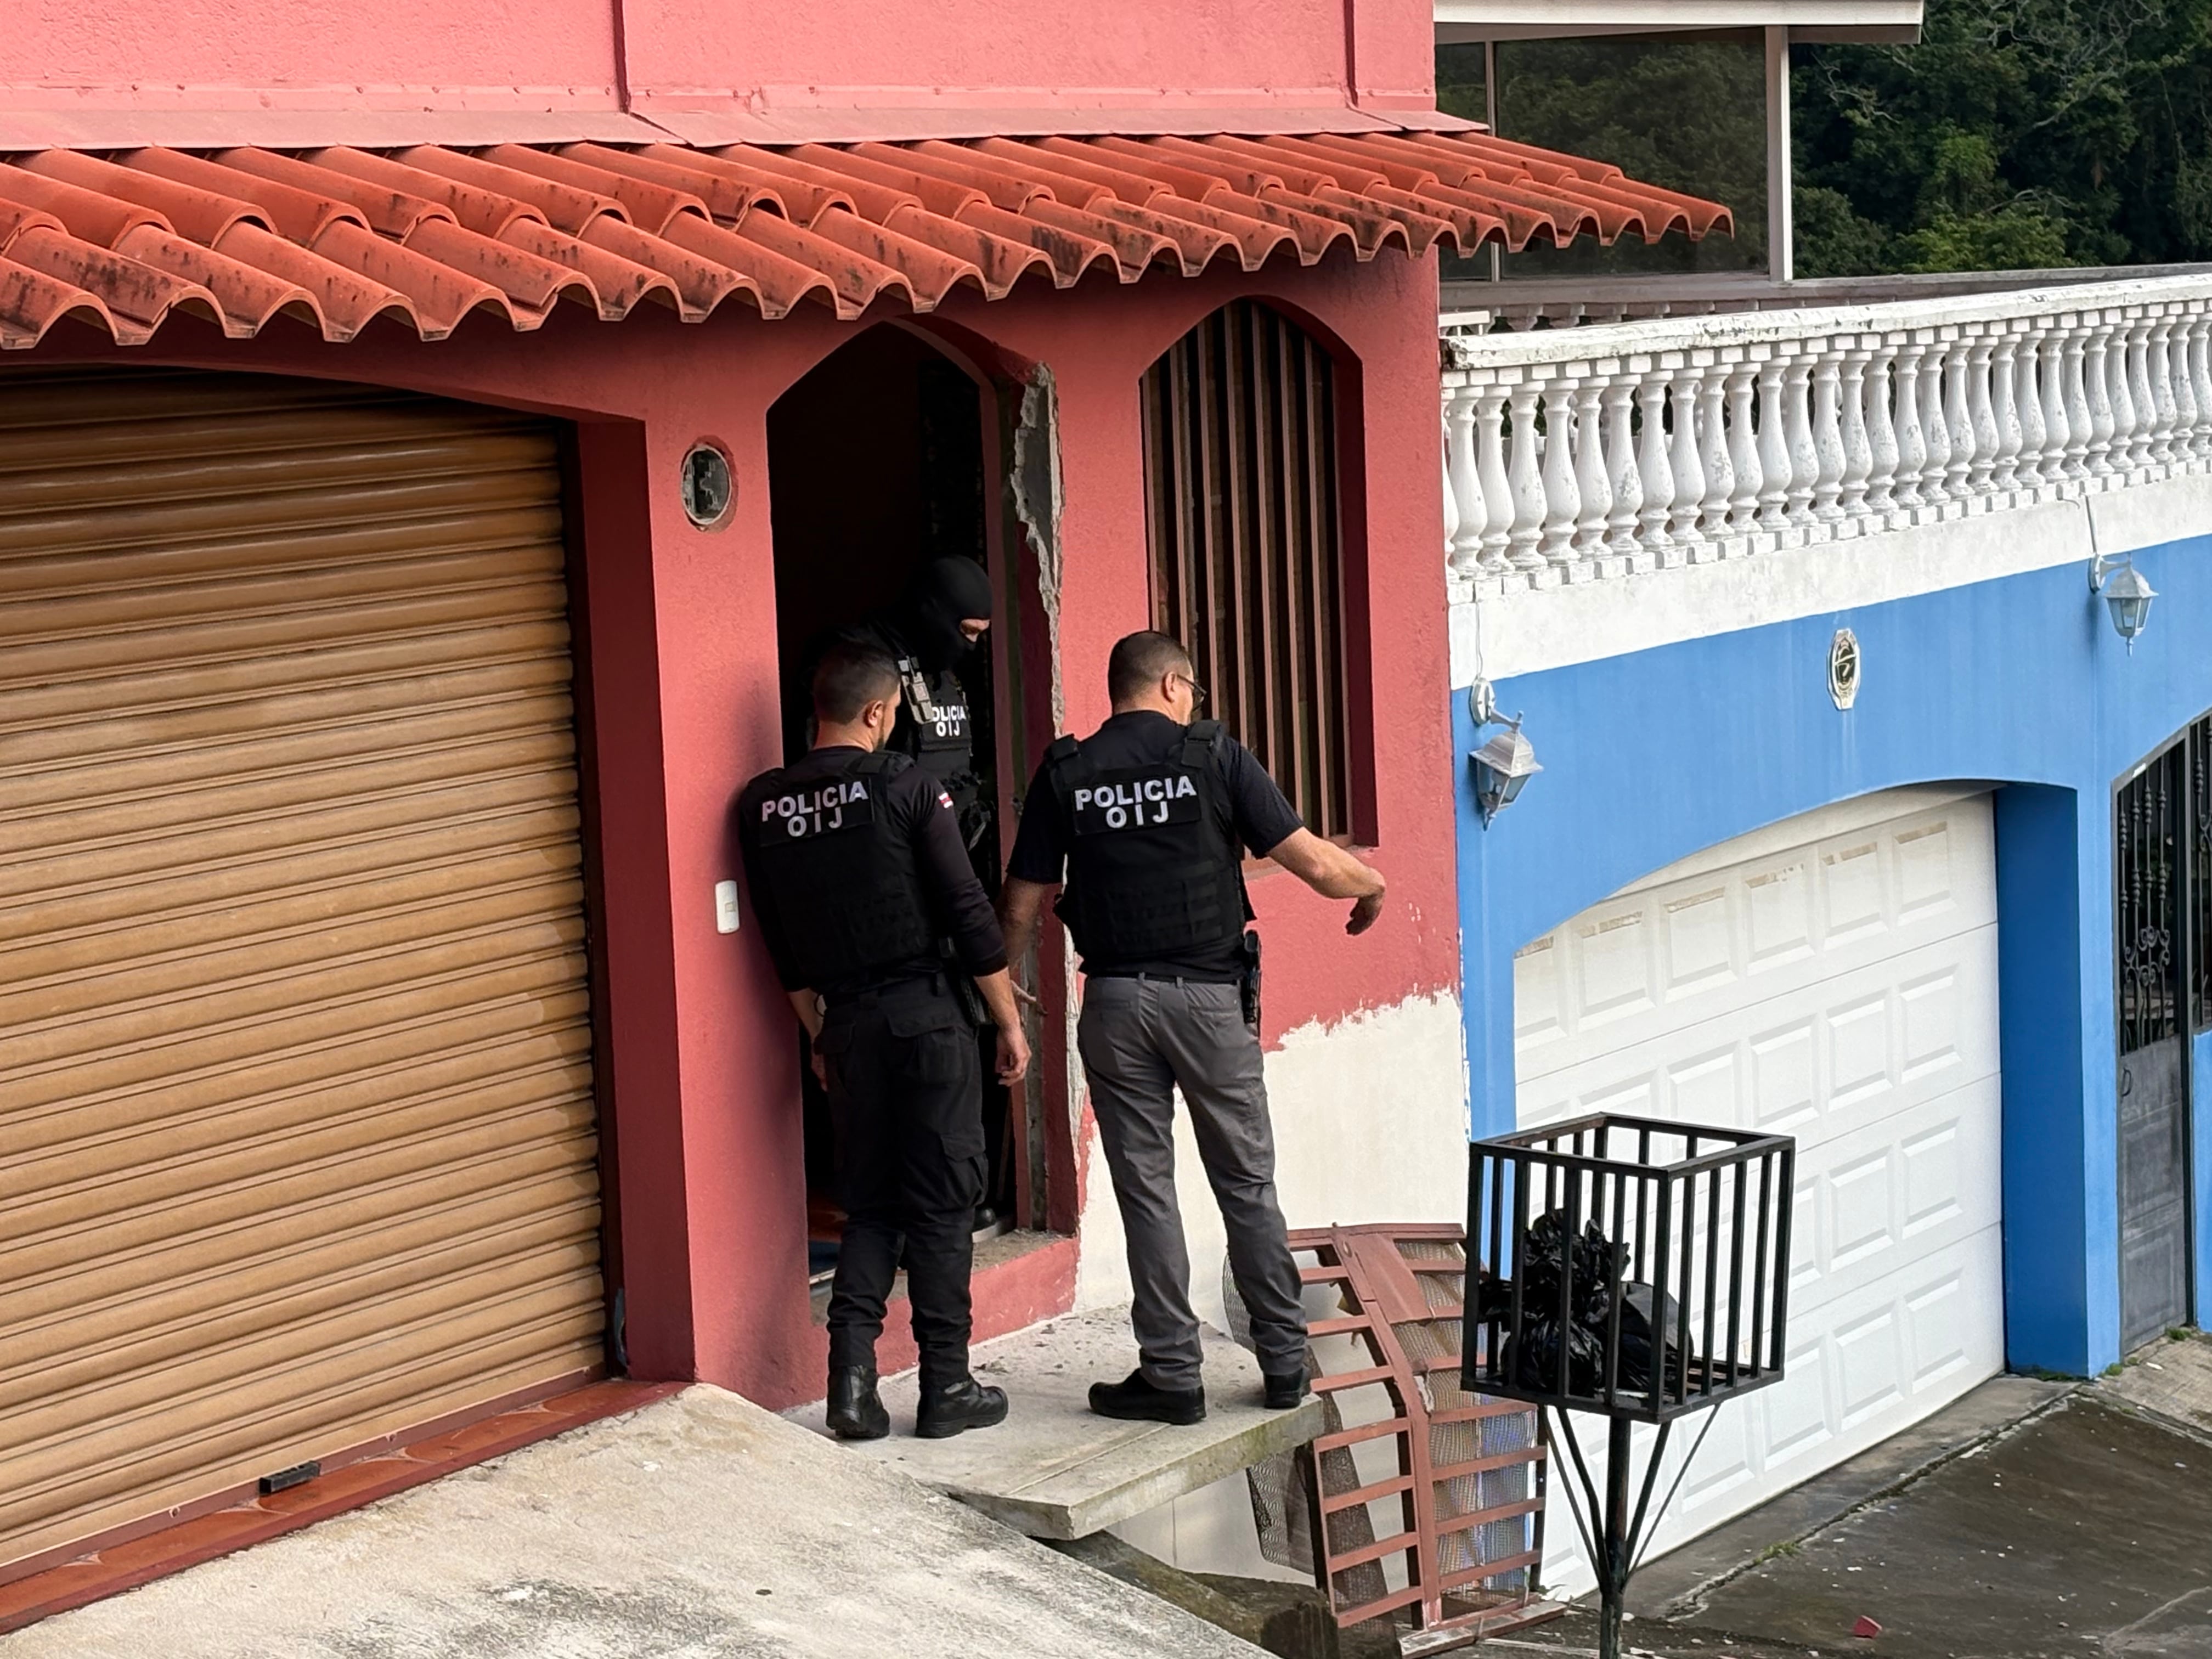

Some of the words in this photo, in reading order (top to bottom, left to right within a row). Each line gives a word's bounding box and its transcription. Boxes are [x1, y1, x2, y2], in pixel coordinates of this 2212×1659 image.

[932, 706, 966, 721] OLICIA
[936, 721, 960, 737] OIJ
[762, 781, 868, 821] POLICIA
[1075, 775, 1197, 811] POLICIA
[787, 806, 843, 837] OIJ
[1106, 801, 1169, 828] OIJ
